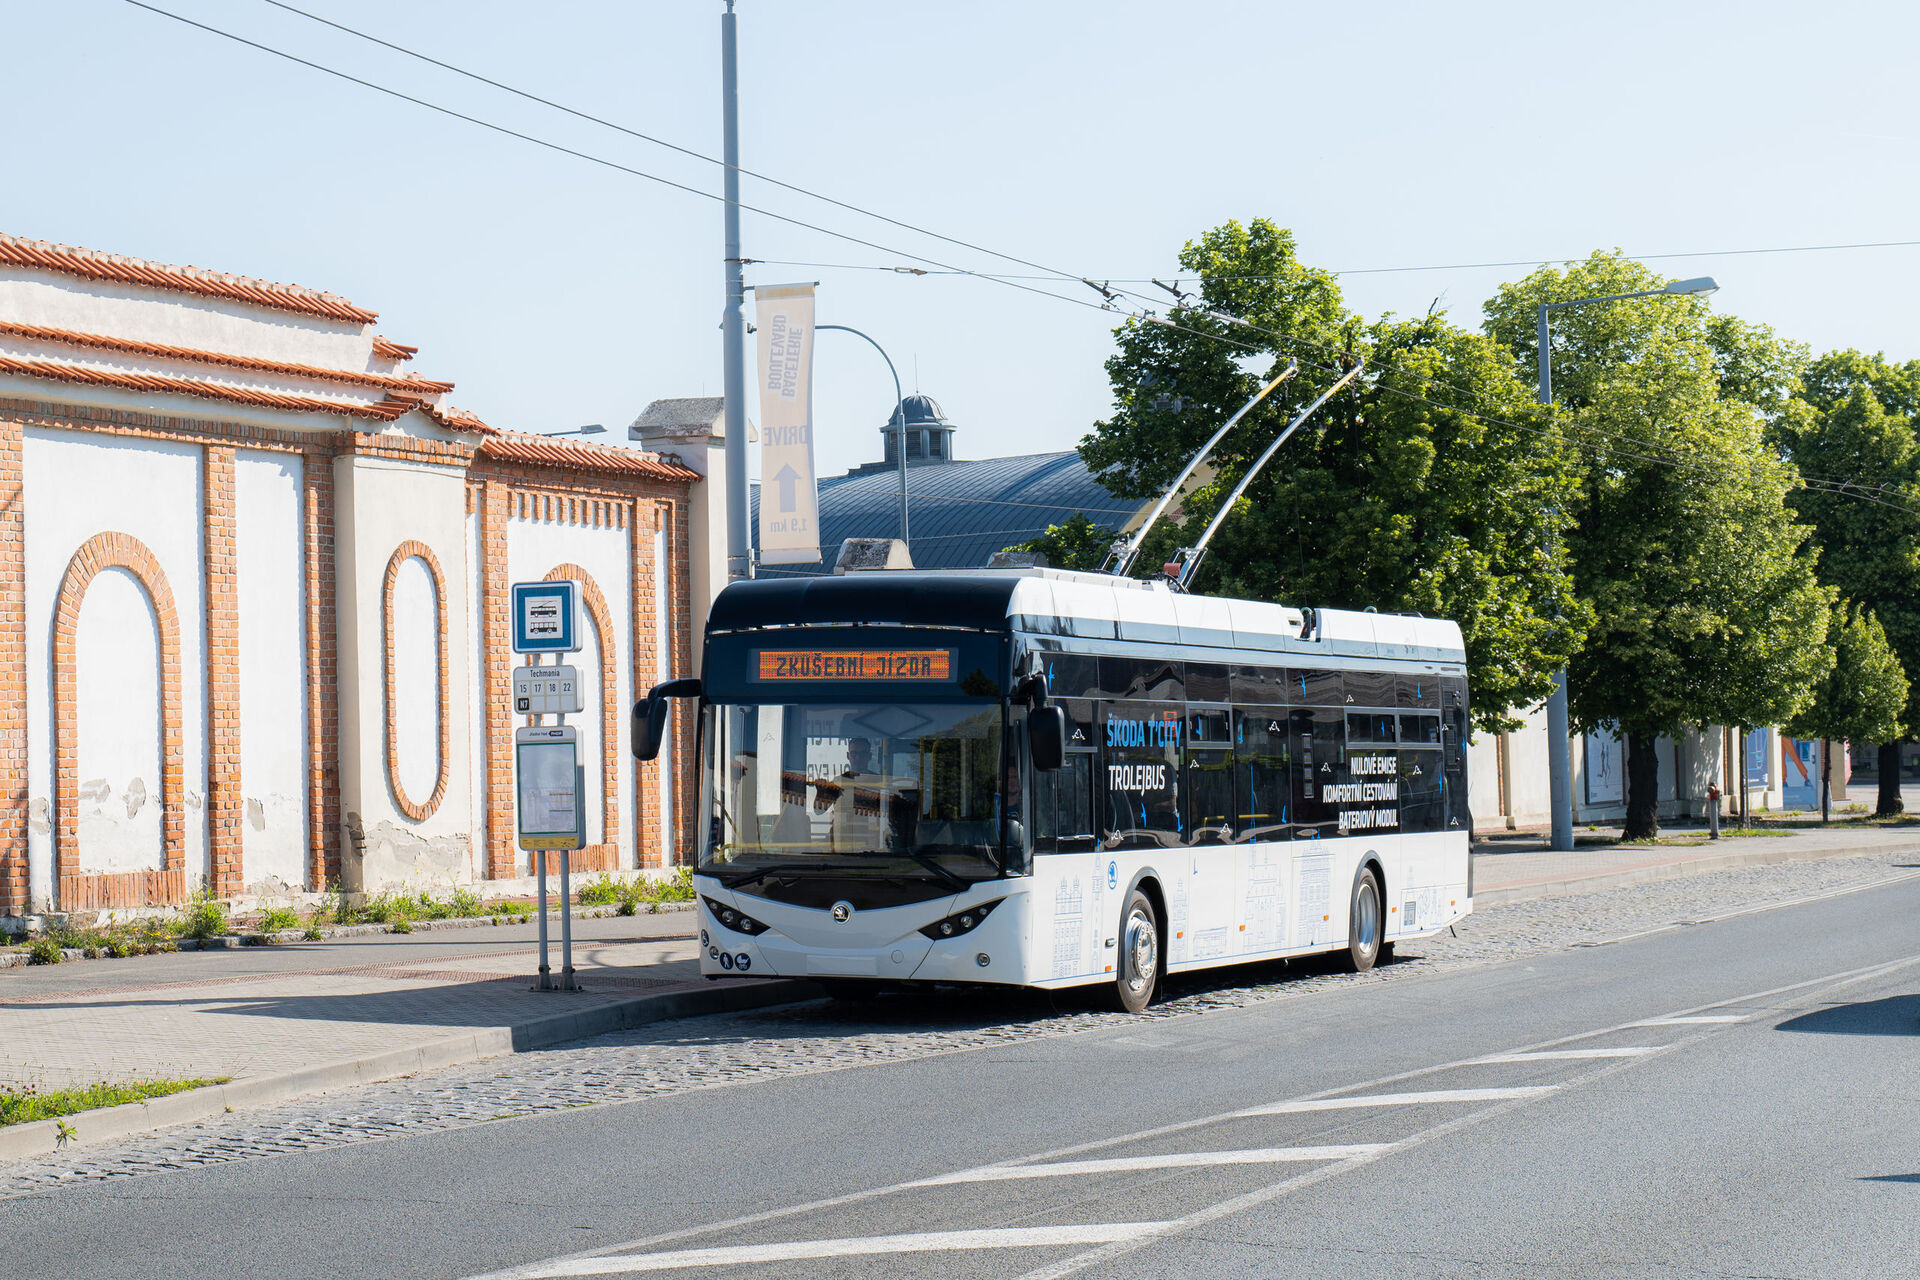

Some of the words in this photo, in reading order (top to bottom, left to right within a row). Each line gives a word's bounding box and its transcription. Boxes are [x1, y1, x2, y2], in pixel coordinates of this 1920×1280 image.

[530, 669, 560, 678] Techmania
[776, 653, 865, 678] ZKUŠEBNÍ
[876, 653, 931, 678] JÍZDA
[520, 684, 527, 693] 15
[534, 684, 541, 693] 17
[549, 683, 556, 692] 18
[563, 683, 571, 692] 22
[520, 700, 528, 708] N7
[1107, 713, 1145, 748] ŠKODA
[1351, 753, 1376, 775] NULOVÉ
[1377, 756, 1397, 775] EMISE
[1108, 764, 1166, 797] TROLEJBUS
[1323, 780, 1362, 803] KOMFORTNÍ
[1363, 779, 1398, 802] CESTOVÁNÍ
[1339, 806, 1375, 830] BATERIOVÝ
[1376, 809, 1398, 828] MODUL
